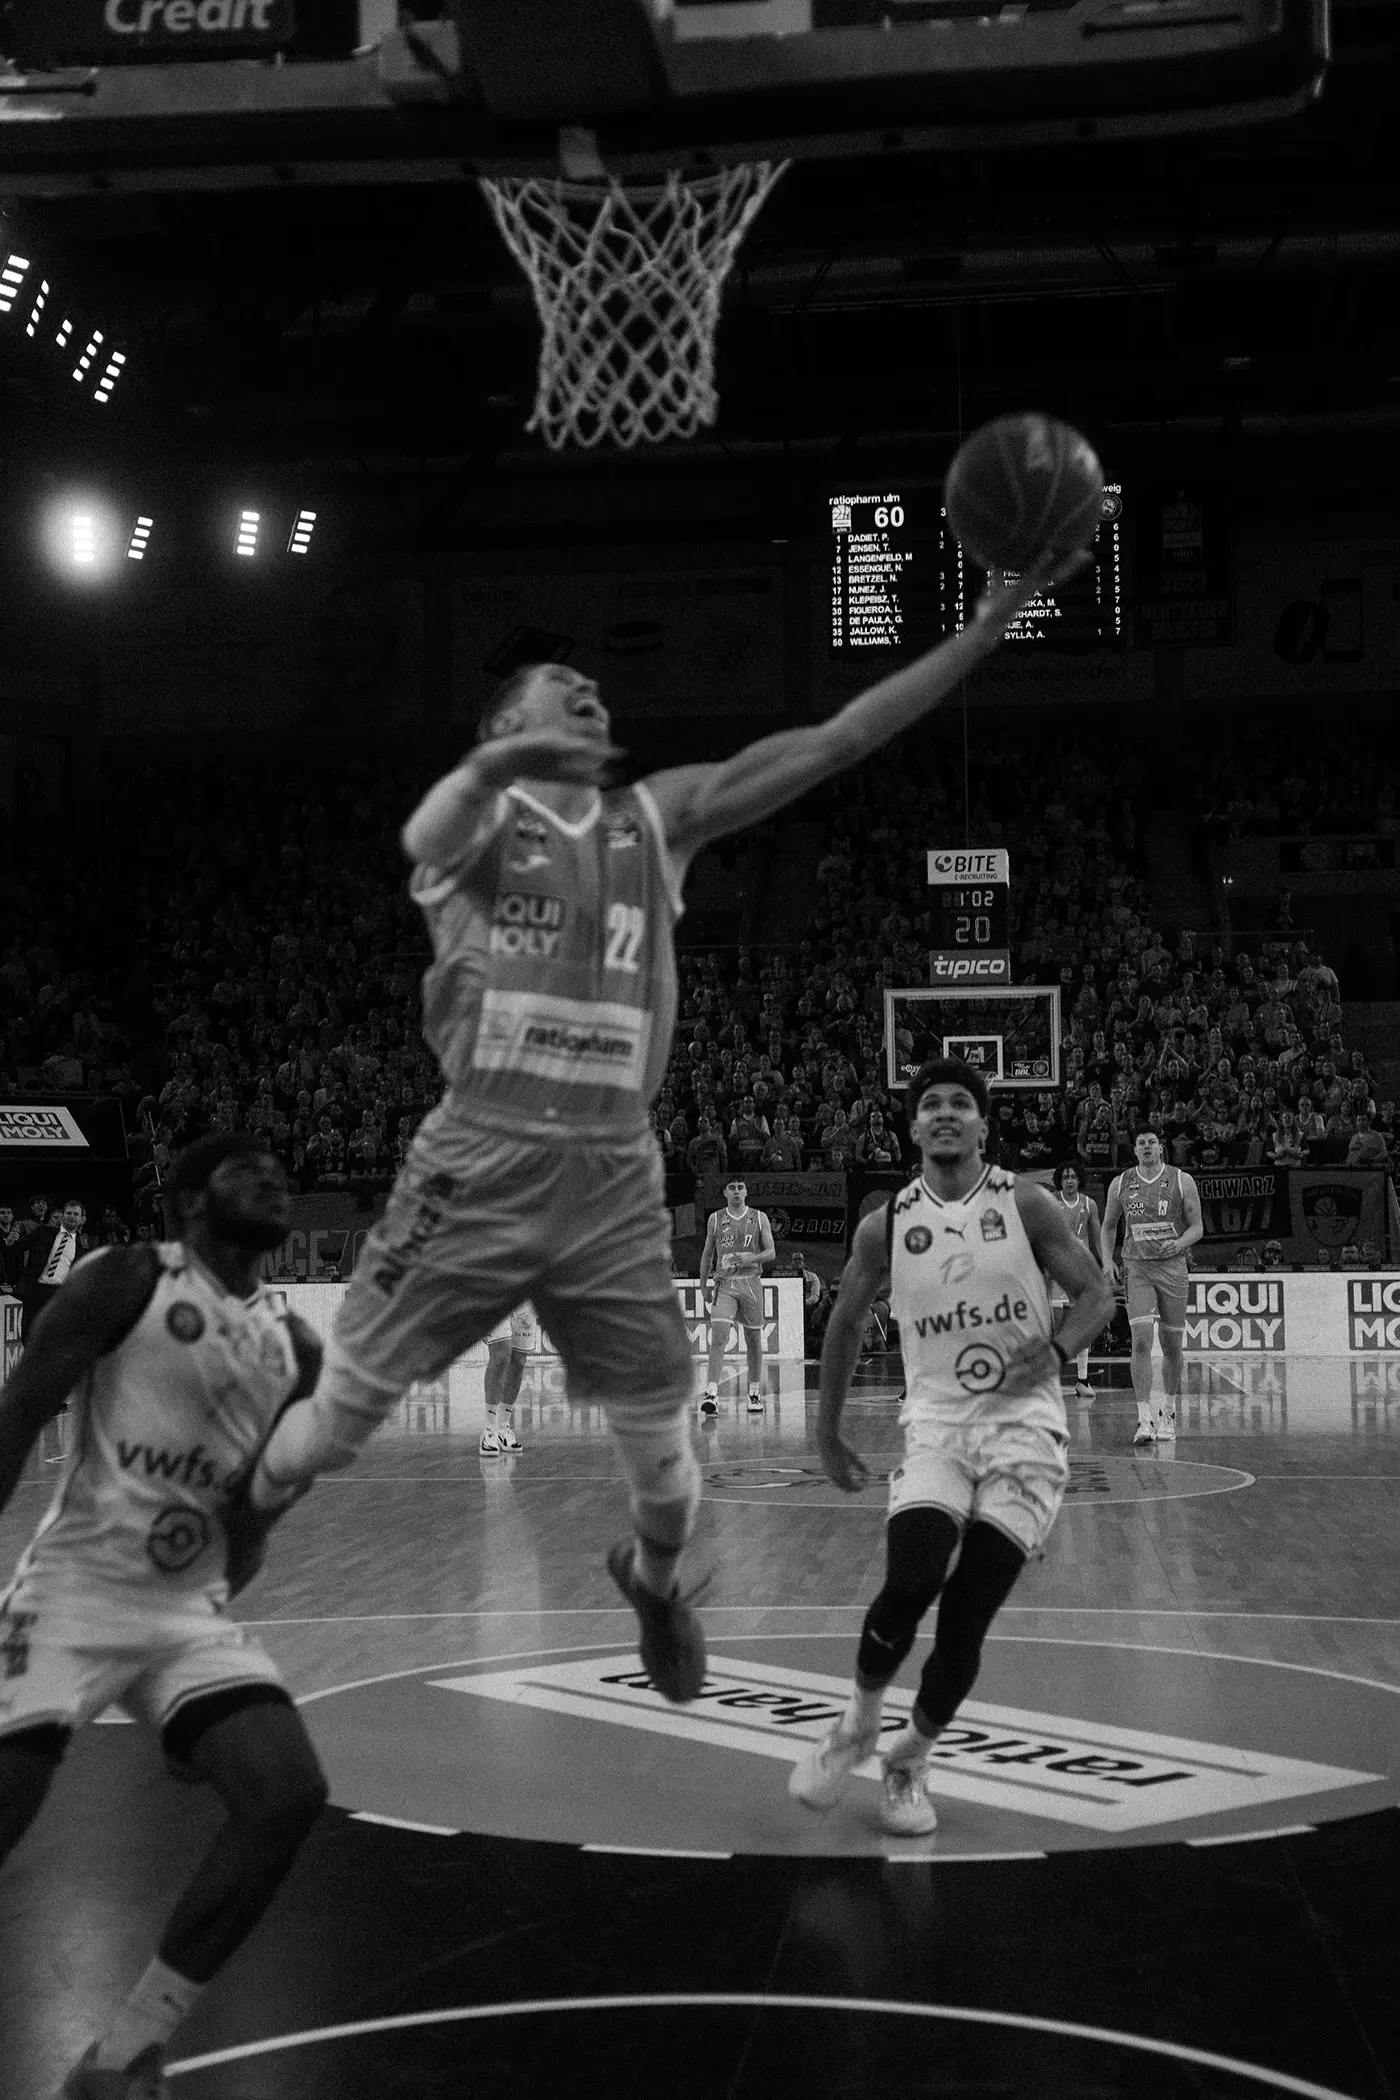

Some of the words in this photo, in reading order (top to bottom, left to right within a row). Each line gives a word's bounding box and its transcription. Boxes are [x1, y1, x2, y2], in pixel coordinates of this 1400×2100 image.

[829, 495, 880, 506] ratiopharm
[883, 493, 900, 503] ulm
[874, 506, 904, 528] 60
[941, 507, 946, 516] 3
[1113, 523, 1119, 531] 6
[837, 535, 840, 543] 1
[848, 533, 880, 542] DADIET,
[940, 530, 943, 538] 1
[1113, 533, 1119, 541] 6
[836, 545, 841, 554] 7
[849, 543, 880, 553] JENSEN,
[883, 543, 890, 551] T.
[940, 541, 944, 549] 2
[848, 553, 903, 563] LANGENFELD,
[1114, 554, 1119, 562] 5
[832, 566, 841, 574] 12
[849, 564, 893, 573] ESSENGUE,
[958, 560, 963, 568] 0
[832, 576, 841, 584] 13
[849, 575, 888, 583] BRETZEL,
[940, 571, 944, 580] 3
[958, 571, 962, 579] 4
[833, 586, 841, 594] 17
[849, 585, 877, 594] NUNEZ,
[958, 581, 963, 589] 7
[1115, 585, 1120, 593] 5
[832, 597, 842, 605] 22
[849, 595, 889, 604] KLEPEISZ,
[892, 594, 899, 602] T.
[959, 592, 963, 600] 4
[832, 607, 842, 615] 30
[849, 606, 893, 614] FIGUEROA,
[895, 605, 902, 613] L.
[940, 603, 945, 611] 3
[955, 602, 963, 610] 12
[1115, 606, 1120, 614] 0
[832, 617, 842, 626] 32
[849, 617, 860, 625] DE
[862, 616, 893, 624] PAULA,
[1025, 620, 1034, 628] A.
[832, 628, 842, 636] 35
[850, 626, 887, 635] JALLOW,
[888, 626, 897, 634] K.
[955, 623, 963, 631] 10
[1004, 631, 1034, 639] SYLLA,
[1115, 627, 1121, 635] 7
[850, 636, 891, 646] WILLIAMS,
[893, 636, 901, 644] T.
[955, 855, 997, 872] BITE
[954, 873, 998, 881] E-RECRUITING
[955, 916, 990, 943] 20
[934, 955, 1005, 979] tipico
[1, 1126, 63, 1138] MOLY
[1158, 1200, 1168, 1216] 13
[744, 1234, 753, 1248] 17
[678, 1288, 773, 1319] LII
[915, 1293, 1028, 1339] vwfs.de
[1182, 1318, 1283, 1349] MOLY
